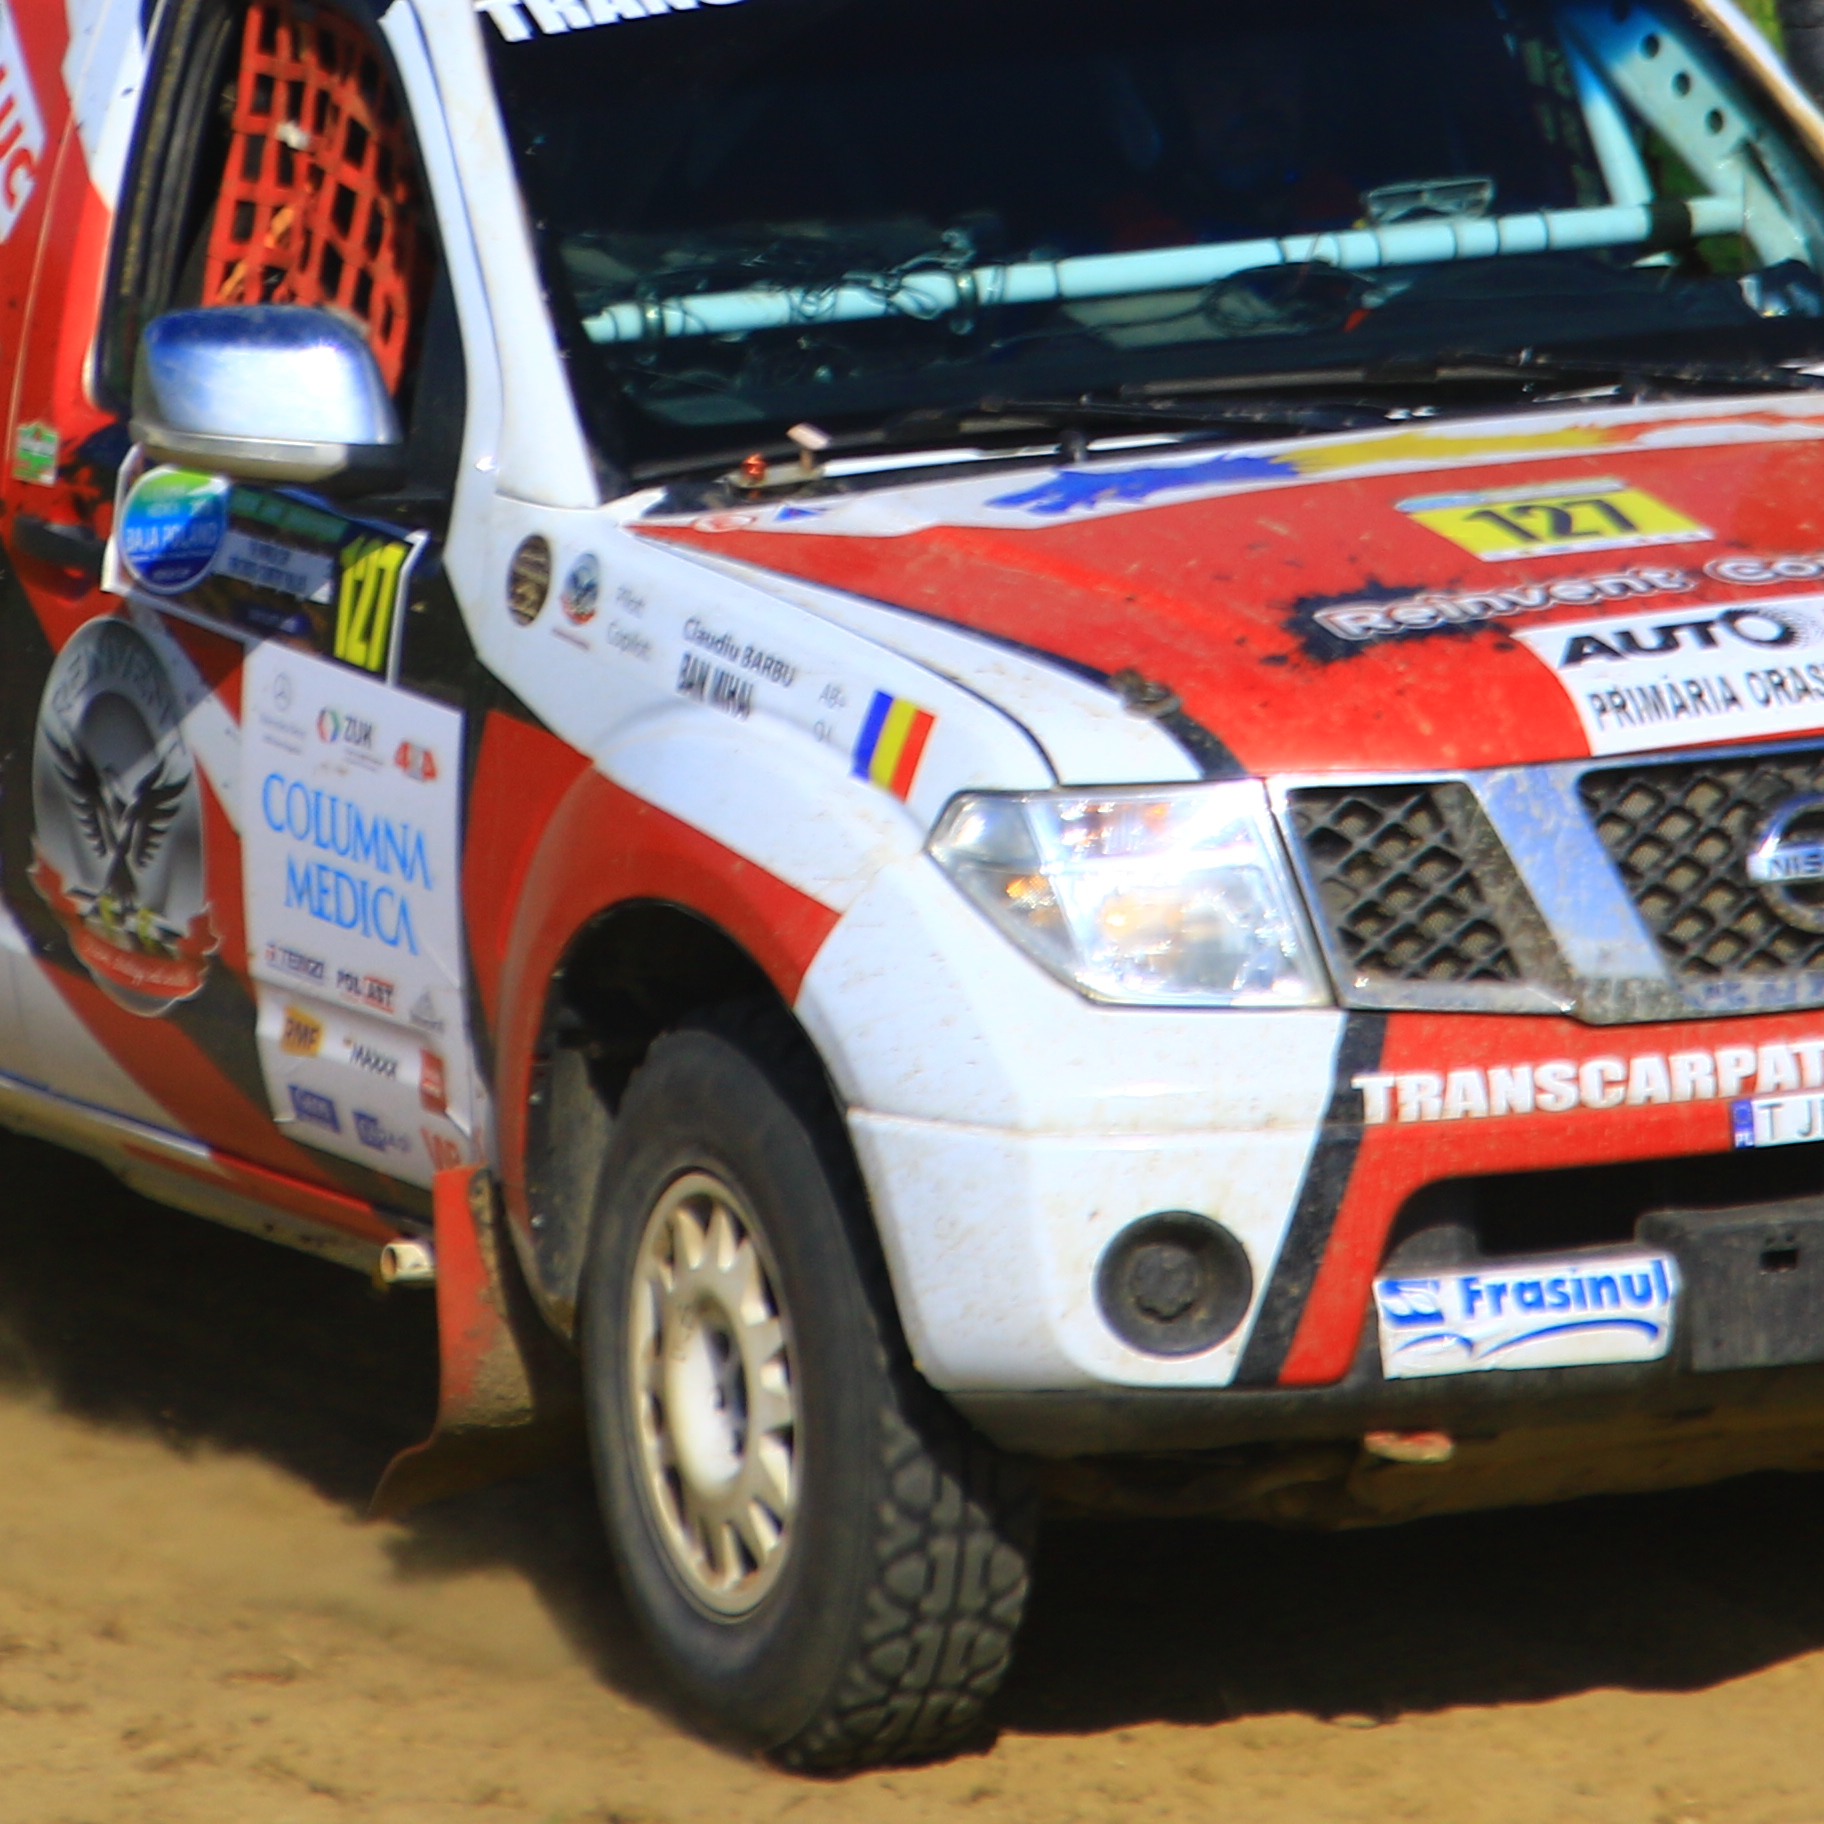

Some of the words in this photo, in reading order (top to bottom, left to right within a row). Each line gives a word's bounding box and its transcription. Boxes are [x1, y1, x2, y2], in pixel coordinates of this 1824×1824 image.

[1460, 498, 1639, 543] 127
[333, 532, 409, 674] 127
[1315, 566, 1696, 639] Reinvent
[740, 643, 800, 688] BARBU
[1557, 607, 1808, 670] AUTO
[262, 772, 434, 891] COLUMNA
[283, 851, 420, 956] MEDICA
[1734, 1131, 1754, 1147] PL
[1458, 1256, 1674, 1322] Frasinul
